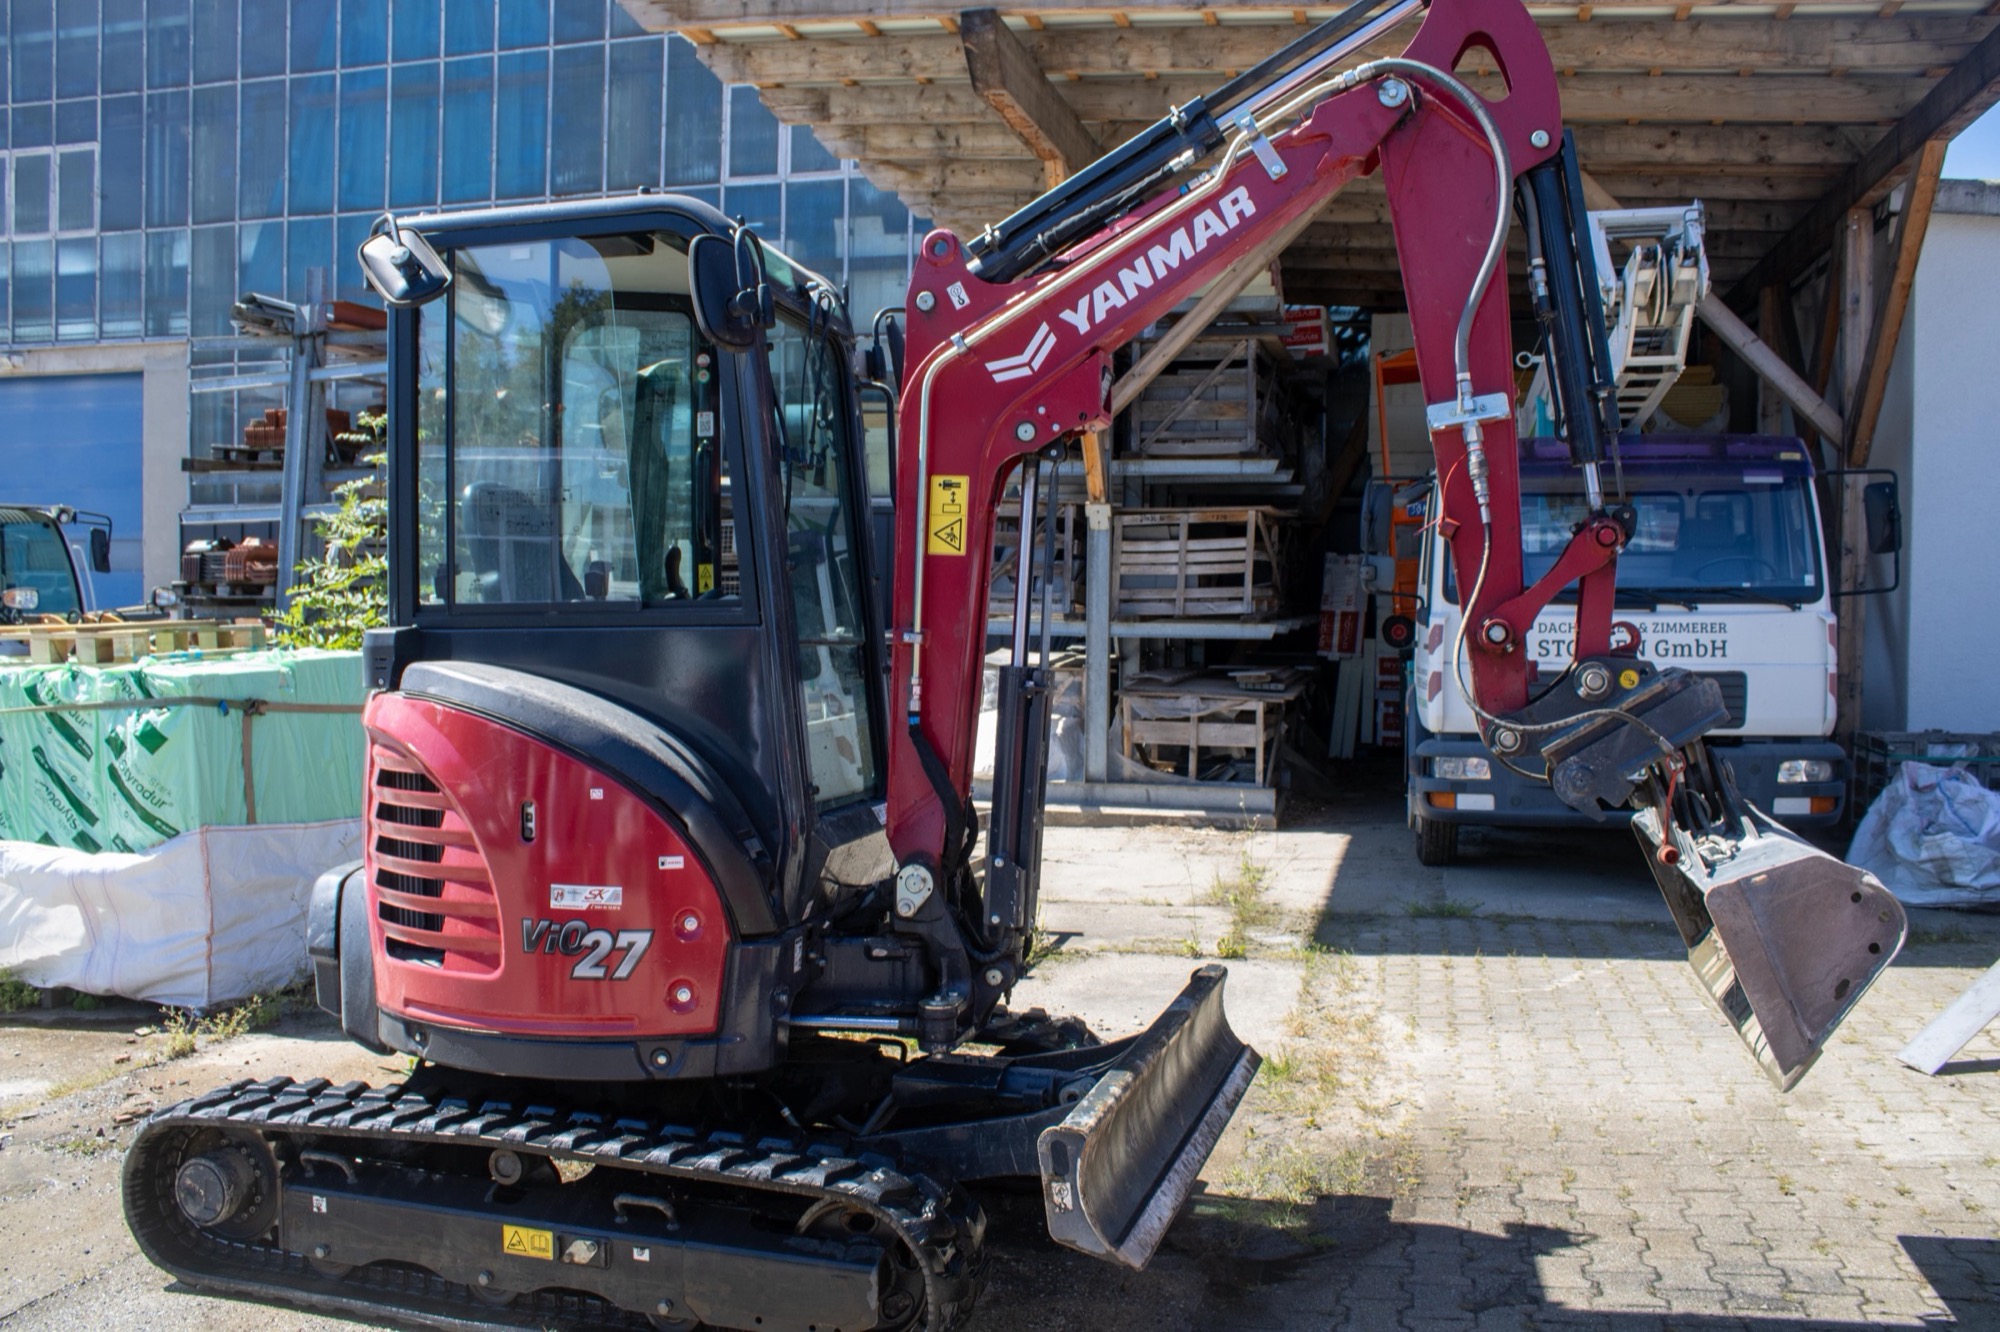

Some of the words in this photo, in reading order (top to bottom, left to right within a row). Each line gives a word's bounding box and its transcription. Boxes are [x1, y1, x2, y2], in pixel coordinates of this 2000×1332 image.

[1059, 185, 1256, 336] YANMAR
[1639, 623, 1648, 634] &
[1652, 623, 1727, 634] ZIMMERER
[1654, 638, 1727, 658] GmbH
